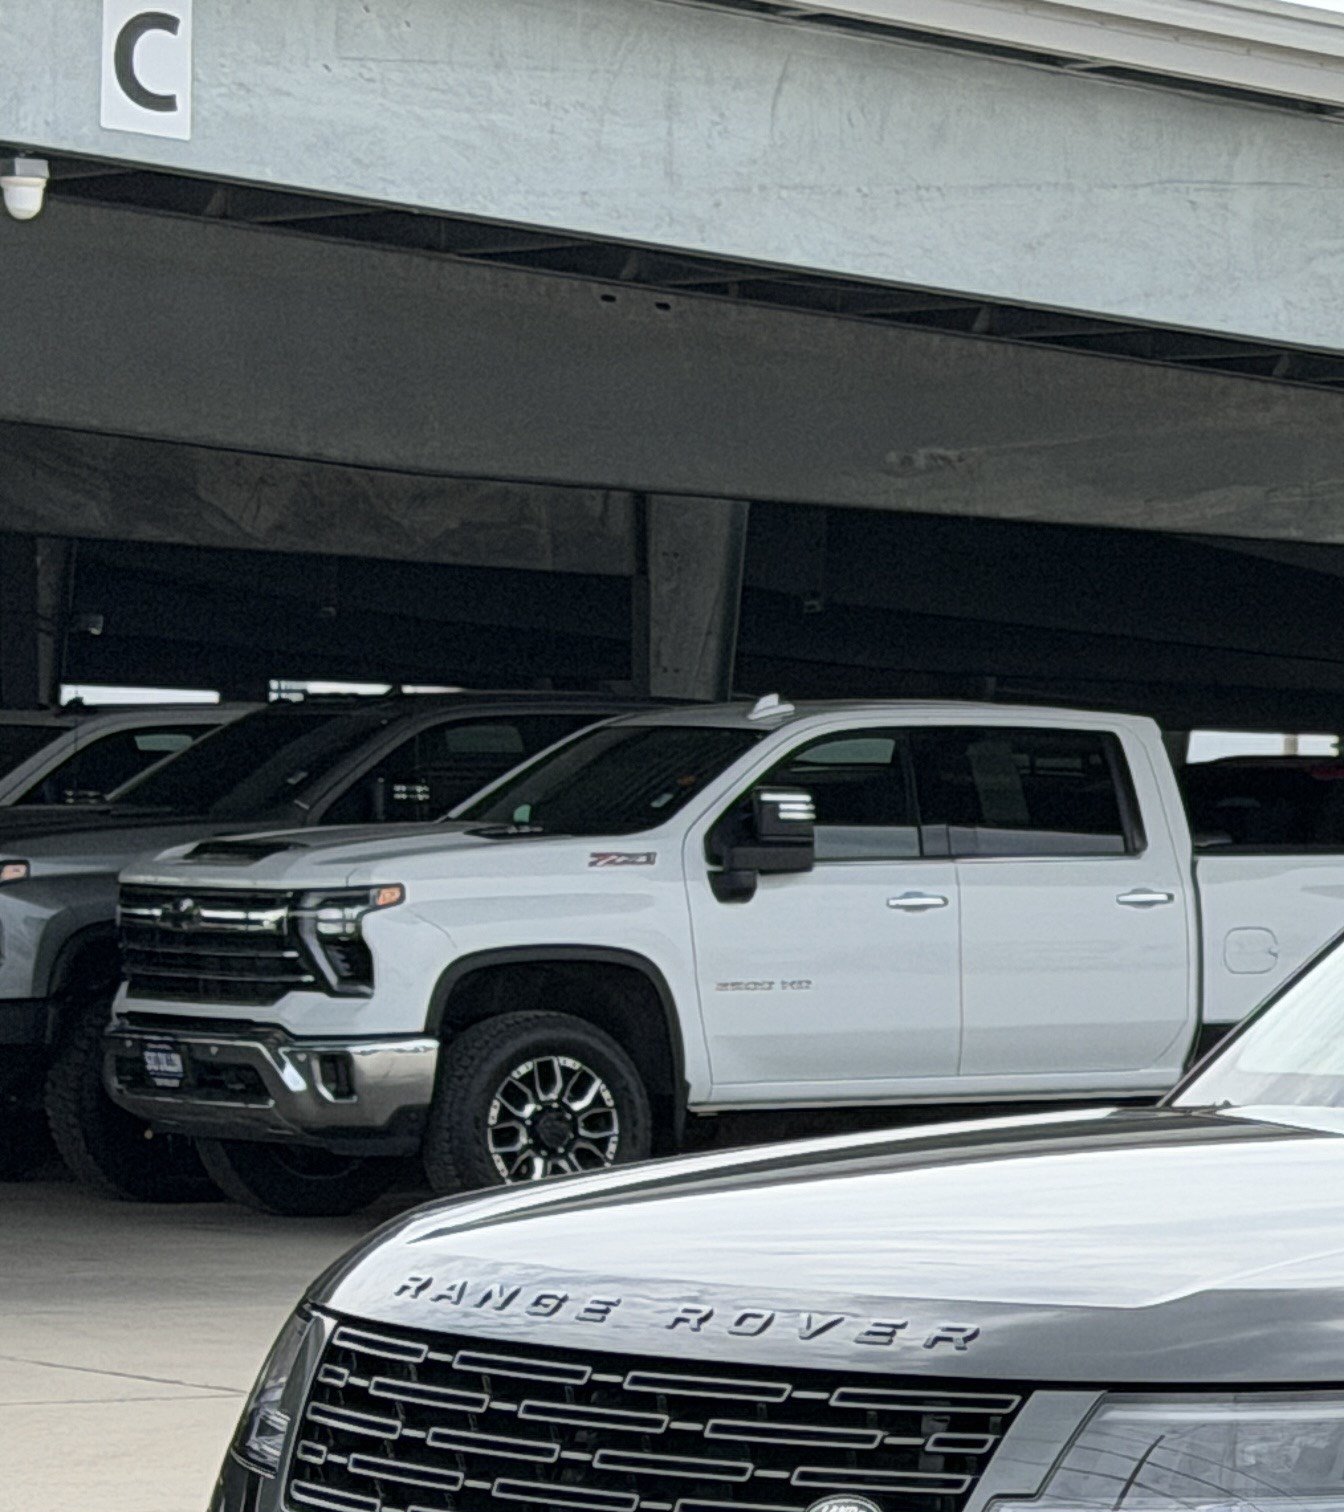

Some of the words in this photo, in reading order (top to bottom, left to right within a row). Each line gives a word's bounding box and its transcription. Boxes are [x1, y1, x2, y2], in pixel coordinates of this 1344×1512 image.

[113, 11, 181, 113] C
[394, 1275, 622, 1324] RANGE
[665, 1303, 980, 1351] ROVER
